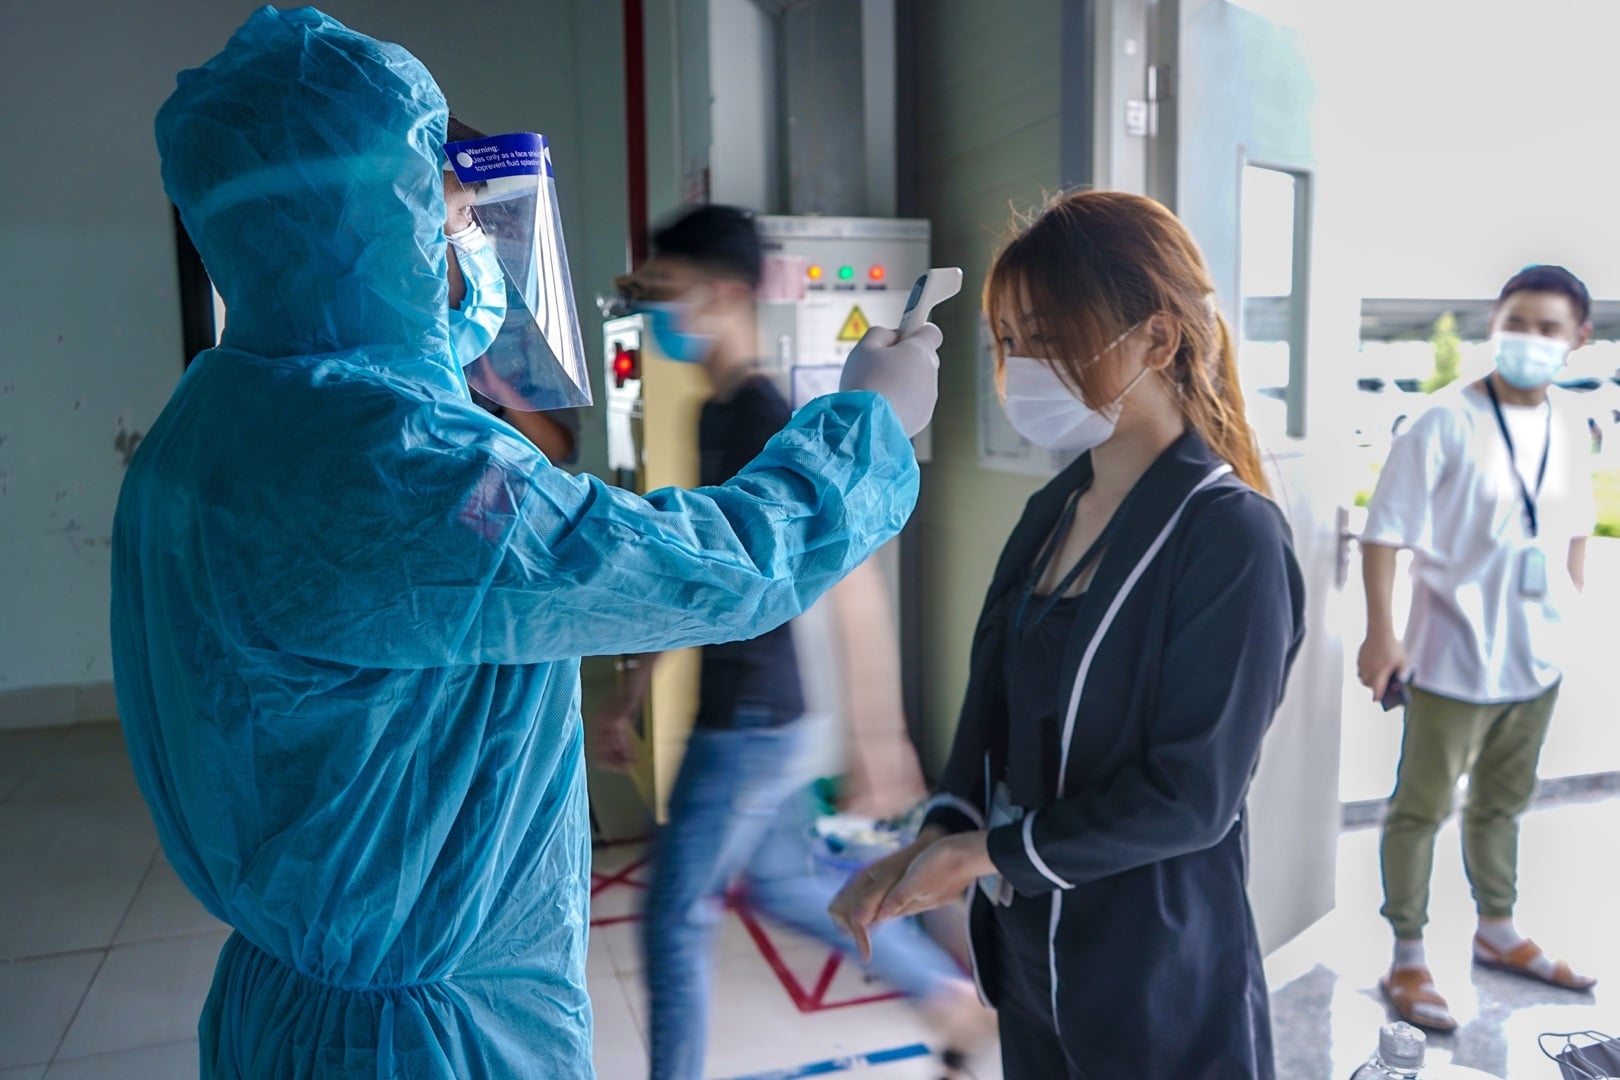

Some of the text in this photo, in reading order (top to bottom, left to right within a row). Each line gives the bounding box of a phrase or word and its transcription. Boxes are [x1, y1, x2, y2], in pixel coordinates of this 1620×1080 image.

[466, 145, 499, 155] Warning:
[486, 153, 500, 162] only
[514, 150, 528, 158] face
[506, 159, 520, 167] fluid
